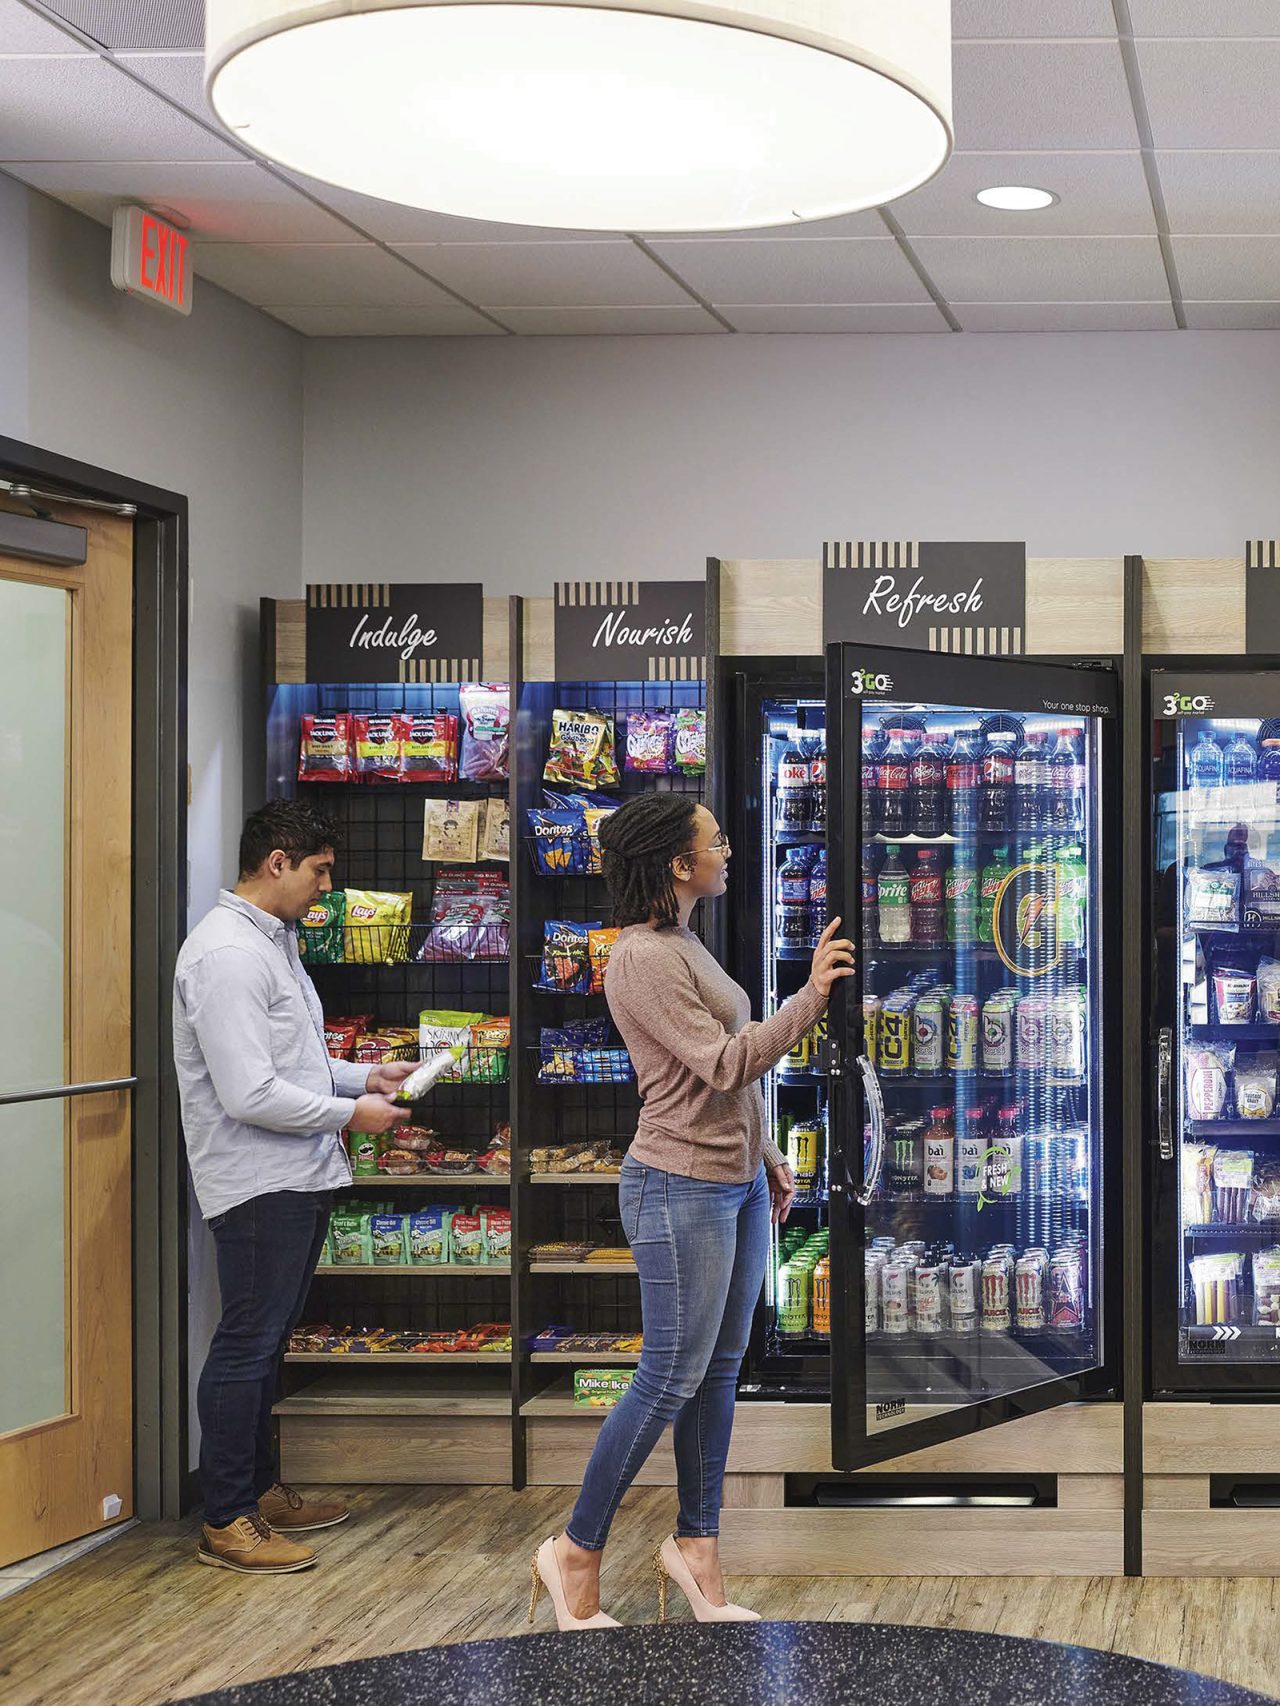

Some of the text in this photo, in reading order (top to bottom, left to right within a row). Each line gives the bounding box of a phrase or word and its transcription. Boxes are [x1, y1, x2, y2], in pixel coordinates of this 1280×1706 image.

[141, 214, 188, 305] EXIT
[863, 575, 984, 628] Refresh
[592, 610, 693, 648] Nourish
[349, 614, 436, 660] Indulge
[1043, 700, 1058, 710] Your
[1076, 702, 1091, 712] stop
[1092, 702, 1110, 714] shop.
[558, 721, 598, 736] HARIBO
[534, 824, 572, 836] Doritos
[552, 932, 588, 944] Doritos
[884, 1016, 902, 1059] C4
[1203, 1071, 1213, 1111] PEPPERONI
[983, 1164, 1008, 1176] FRESH
[981, 1176, 1008, 1189] & NEW
[1189, 1341, 1225, 1349] NORM
[580, 1379, 628, 1389] Mike Ike
[876, 1398, 905, 1414] NORM
